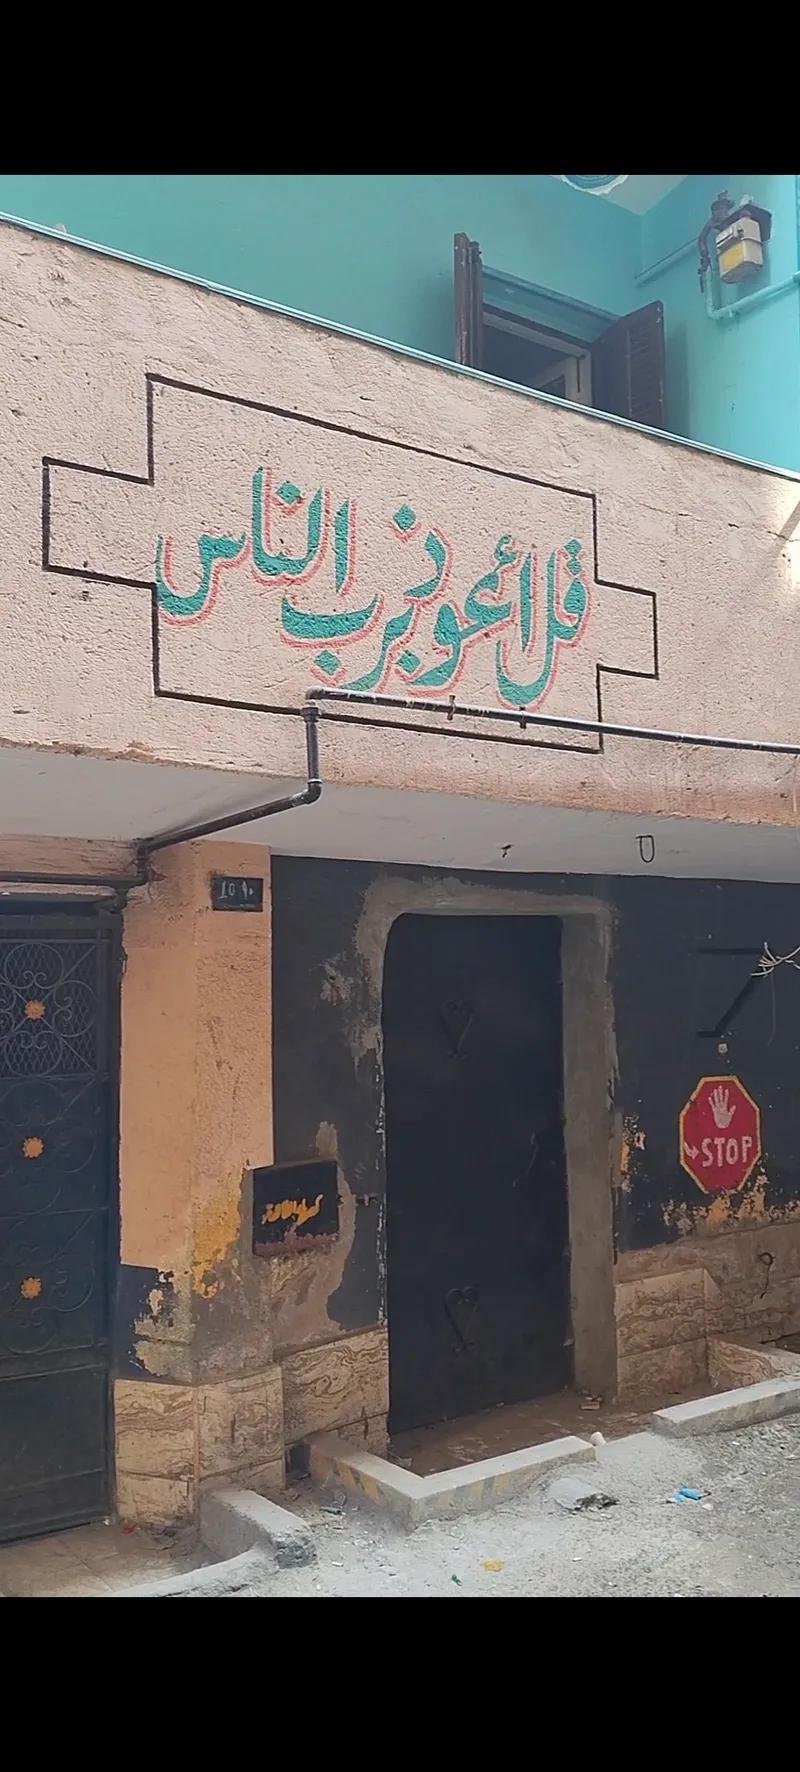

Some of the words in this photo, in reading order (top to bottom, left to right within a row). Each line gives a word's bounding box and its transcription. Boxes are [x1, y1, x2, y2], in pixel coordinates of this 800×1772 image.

[155, 466, 353, 617] الناس
[281, 594, 421, 692] برب
[496, 539, 589, 706] قل
[701, 1136, 753, 1168] STOP
